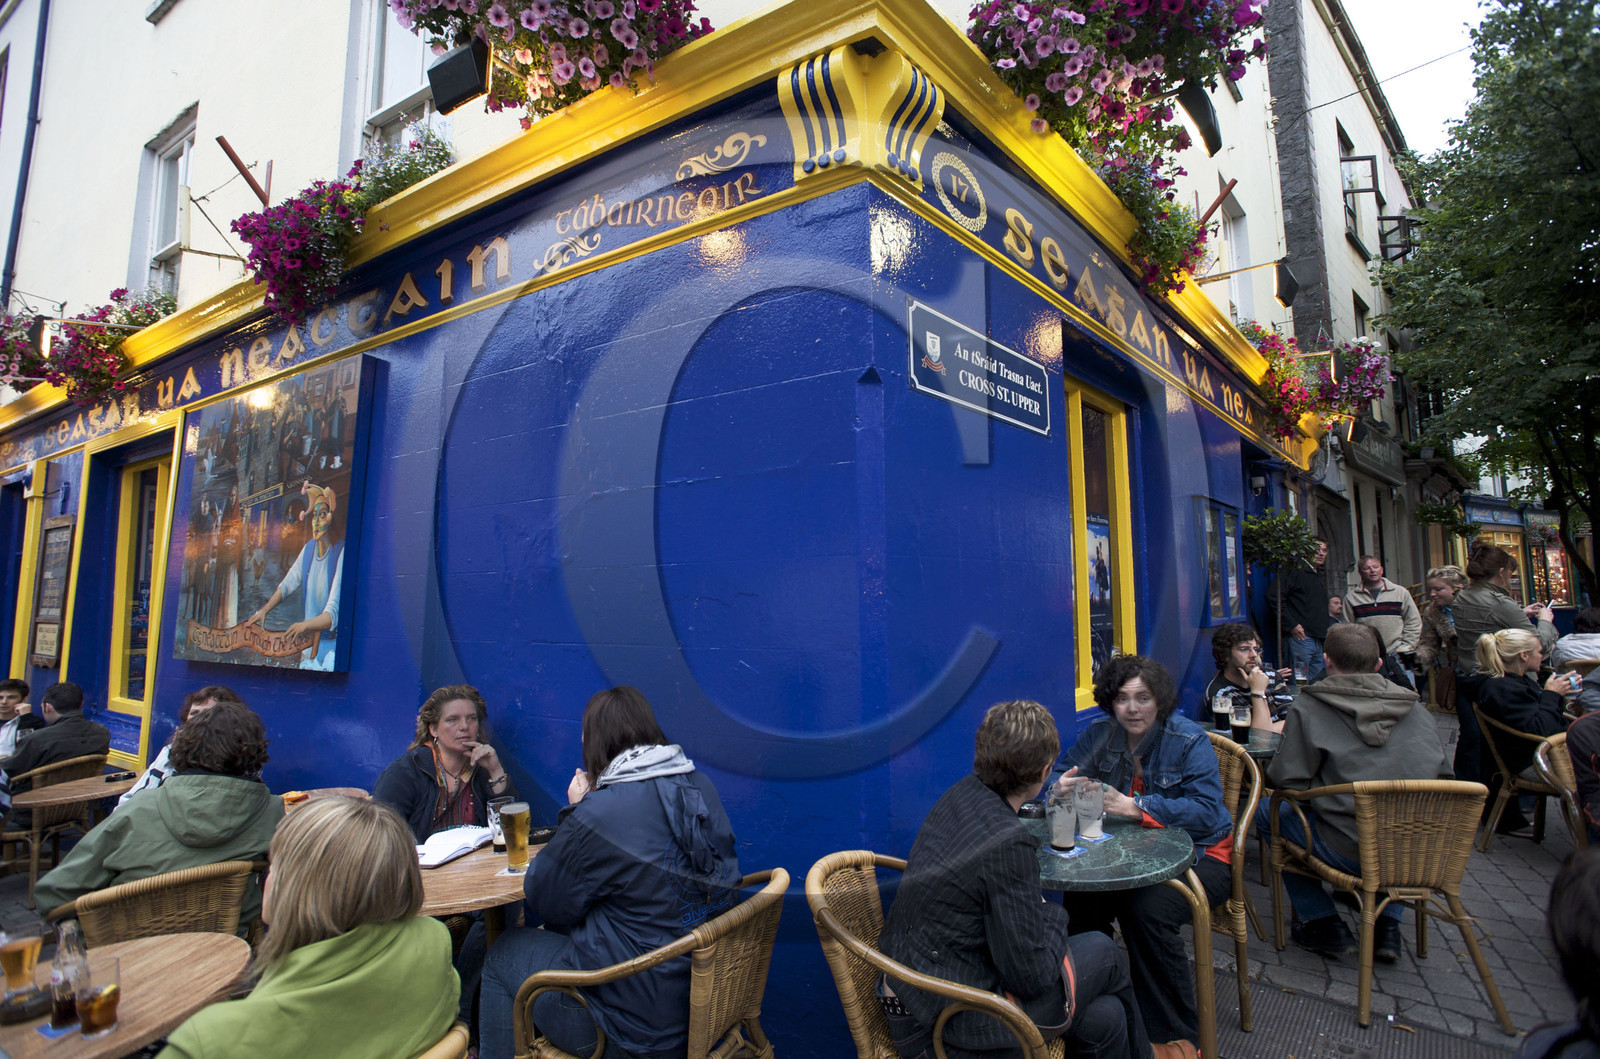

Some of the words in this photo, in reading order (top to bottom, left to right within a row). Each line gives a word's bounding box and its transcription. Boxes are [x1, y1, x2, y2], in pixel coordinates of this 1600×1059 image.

[950, 173, 970, 203] 17
[954, 342, 969, 361] An
[971, 349, 997, 374] tSráid
[999, 361, 1024, 386] Trasna
[1025, 374, 1043, 395] Uact.
[959, 369, 996, 397] CROSS
[997, 384, 1011, 404] ST.
[1011, 393, 1041, 416] UPPER
